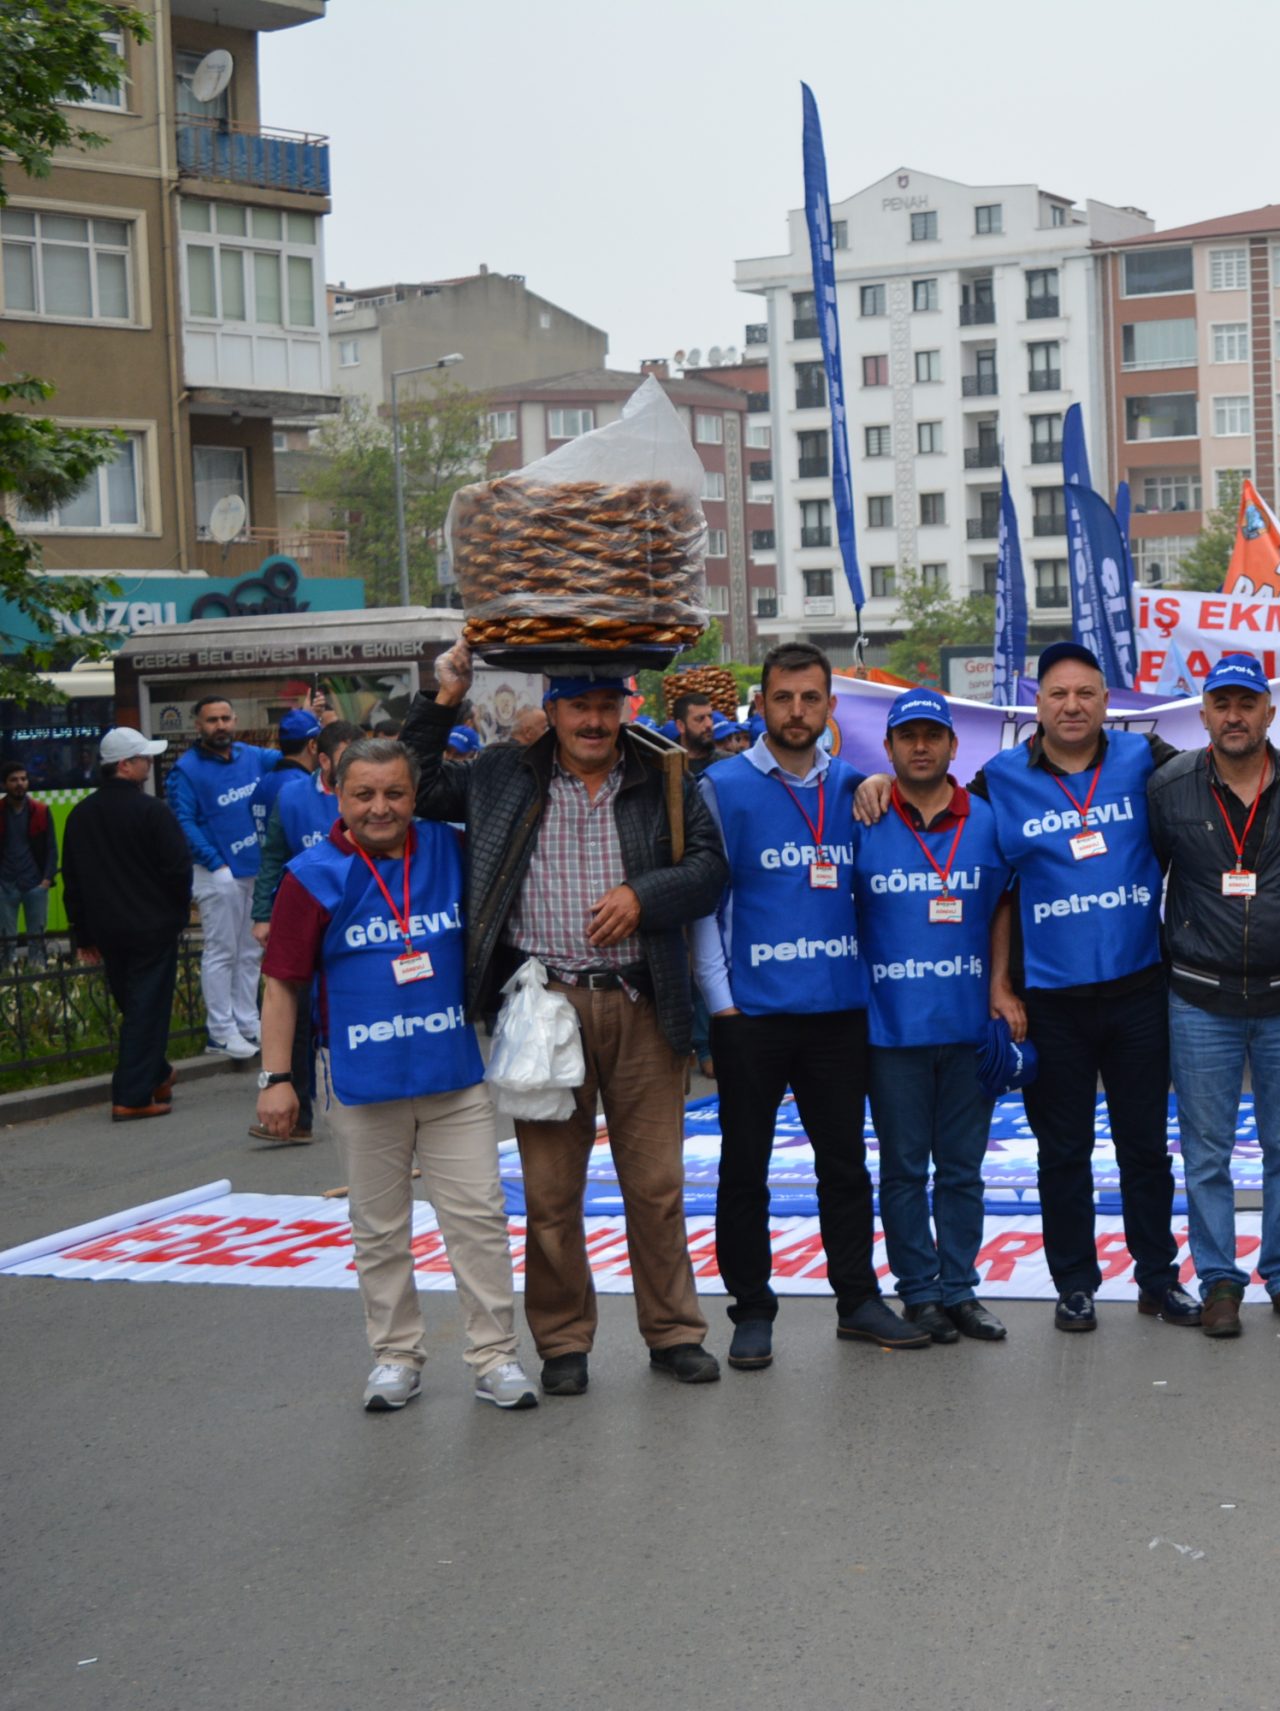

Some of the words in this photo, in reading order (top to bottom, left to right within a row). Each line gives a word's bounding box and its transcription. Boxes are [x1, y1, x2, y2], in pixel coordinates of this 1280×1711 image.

[882, 195, 929, 212] PENAH
[1139, 597, 1181, 638] İŞ
[133, 653, 190, 670] GEBZE
[199, 645, 300, 666] BELEDİYESİ
[306, 643, 353, 661] HALK
[363, 640, 425, 658] EKMEK
[901, 698, 942, 712] petrol-iş
[1022, 797, 1134, 838] GÖREVLİ
[871, 867, 981, 895] GÖREVLİ
[1034, 884, 1151, 924] petrol-iş
[873, 956, 982, 983] petrol-iş
[348, 1004, 465, 1050] petrol-i
